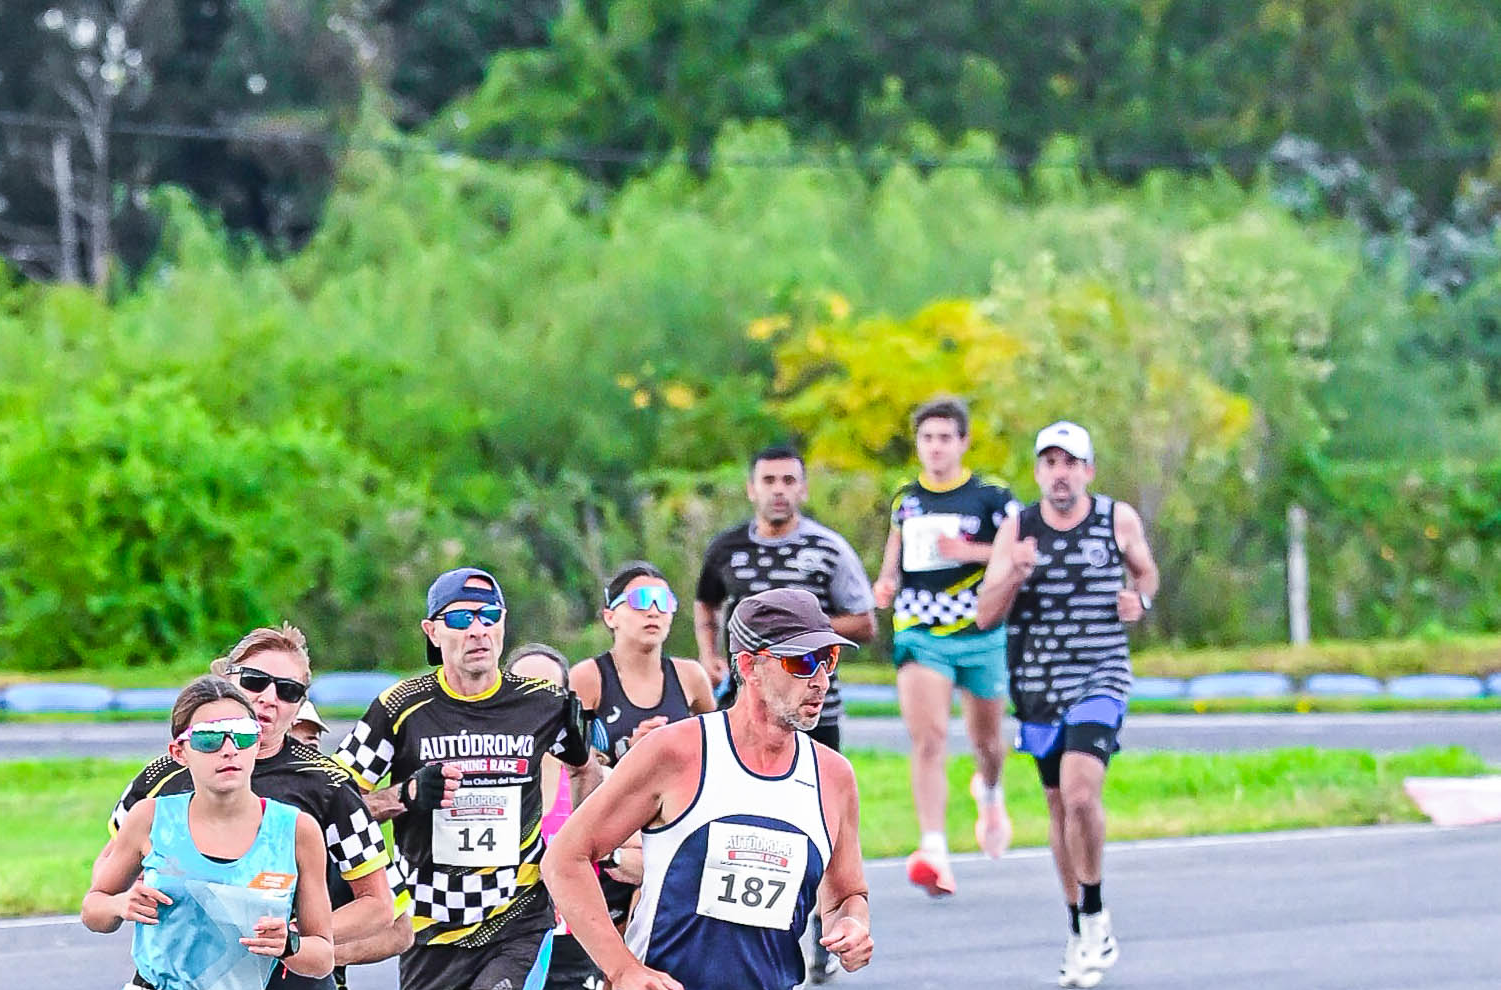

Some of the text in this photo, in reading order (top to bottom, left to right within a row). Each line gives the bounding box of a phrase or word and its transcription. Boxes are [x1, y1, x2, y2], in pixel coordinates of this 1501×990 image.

[419, 729, 535, 760] AUTÓDROMO
[489, 758, 517, 773] RACE
[458, 828, 497, 852] 14
[717, 873, 787, 909] 187
